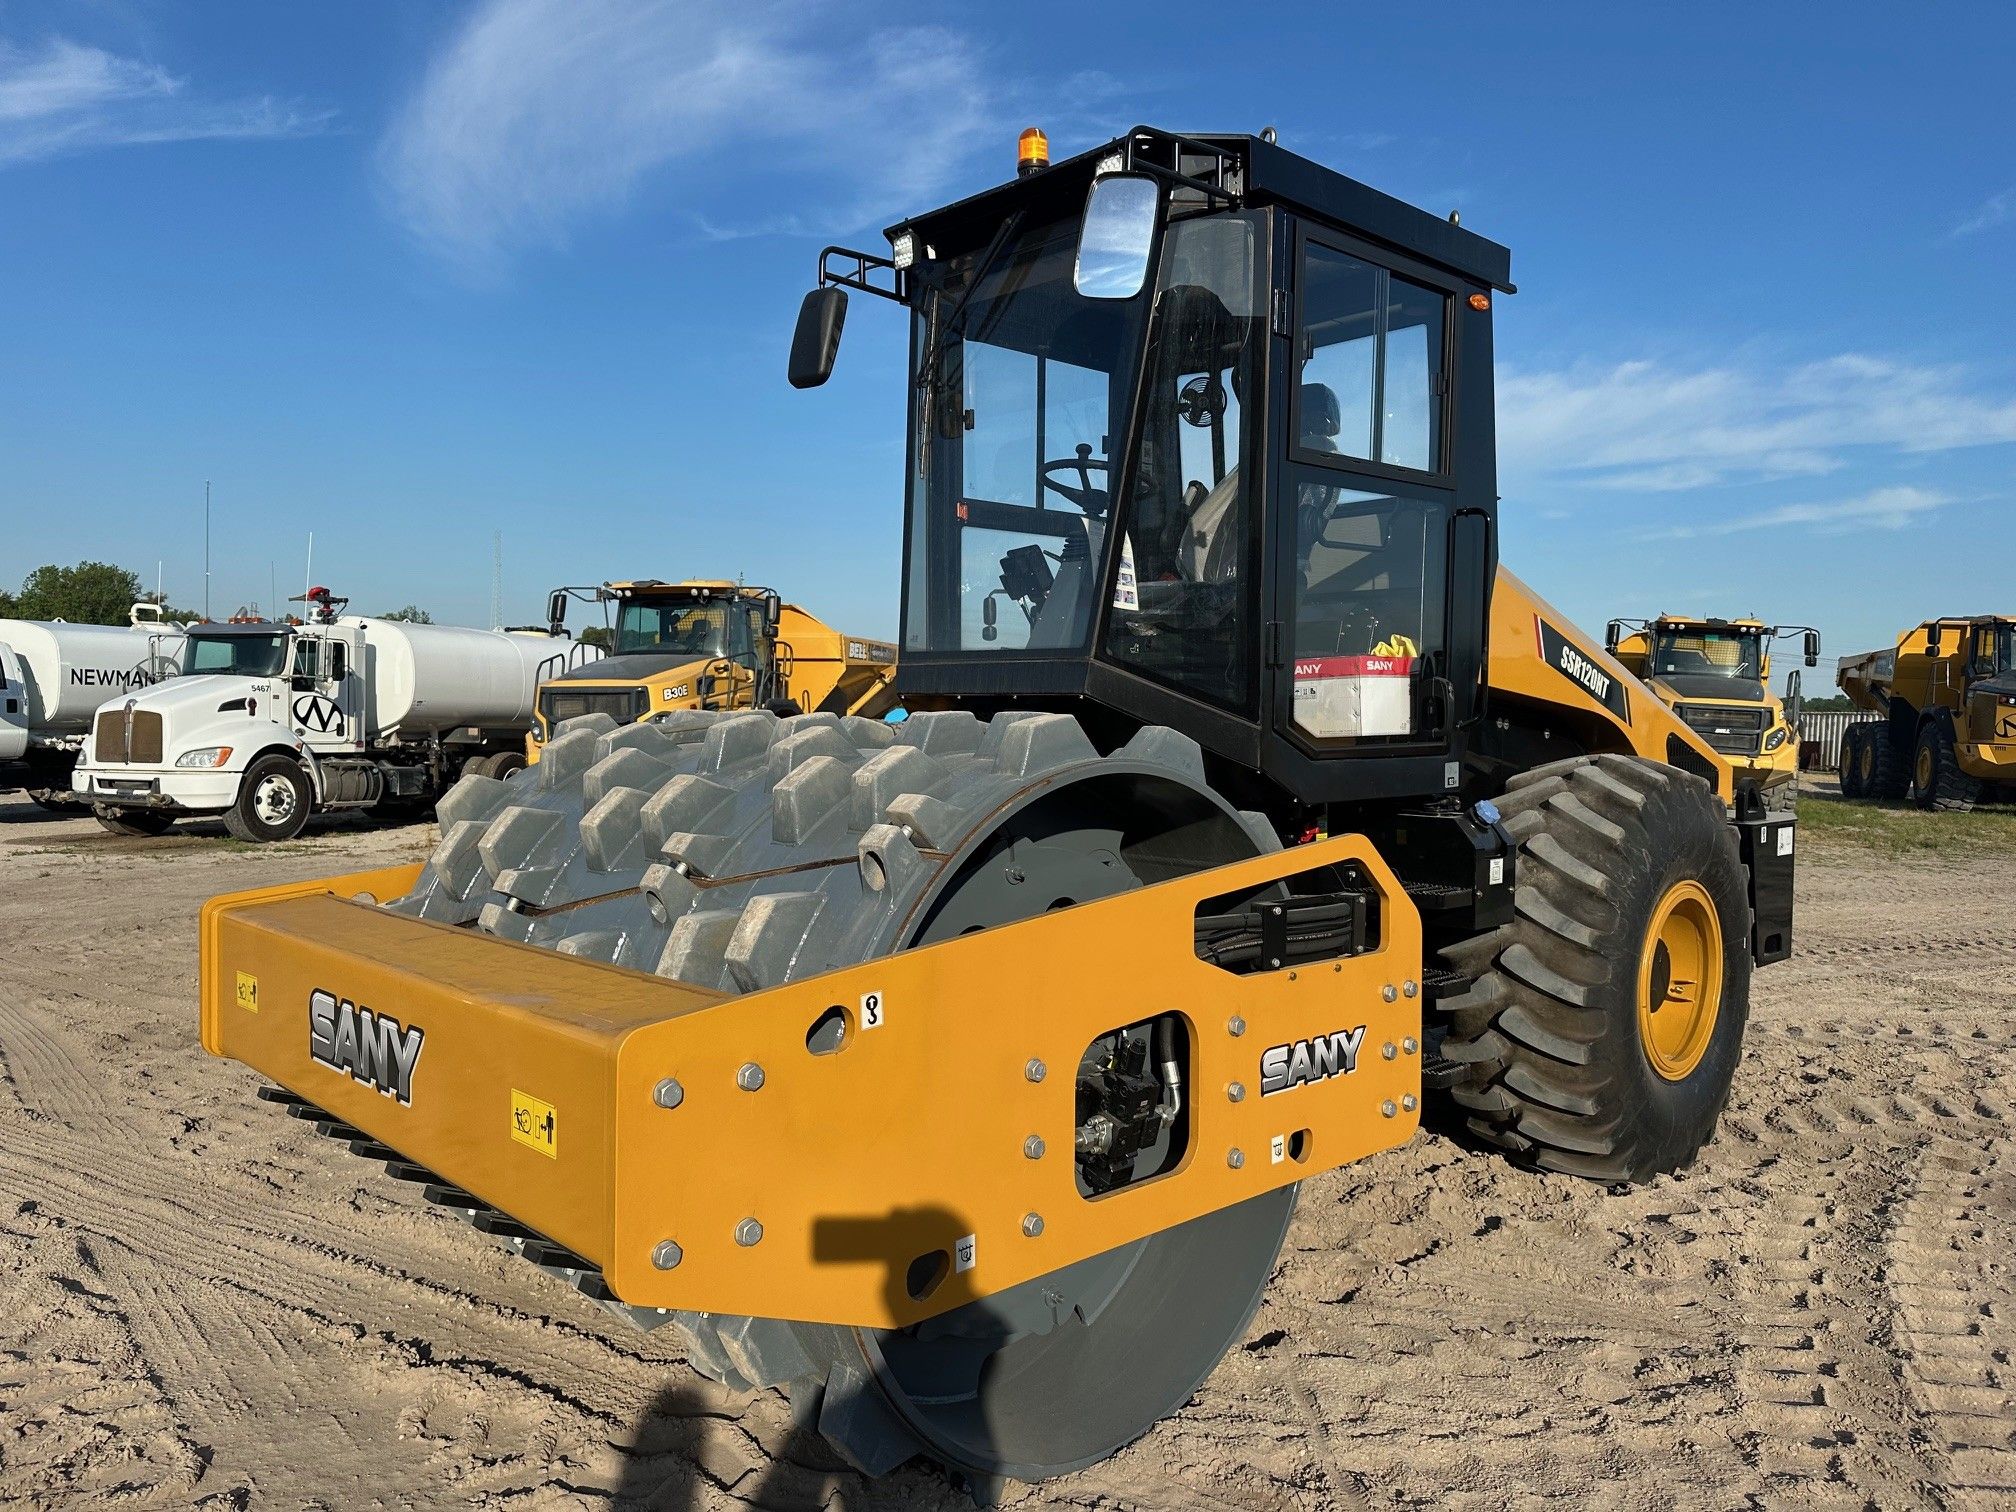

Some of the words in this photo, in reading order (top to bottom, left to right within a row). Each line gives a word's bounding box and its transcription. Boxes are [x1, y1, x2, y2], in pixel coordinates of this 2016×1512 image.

[71, 668, 156, 687] NEWMAN
[1366, 660, 1393, 670] SANY
[1560, 645, 1610, 700] SSR120HT
[663, 684, 688, 701] B30E
[310, 988, 424, 1106] SANY
[1260, 1025, 1367, 1097] SANY
